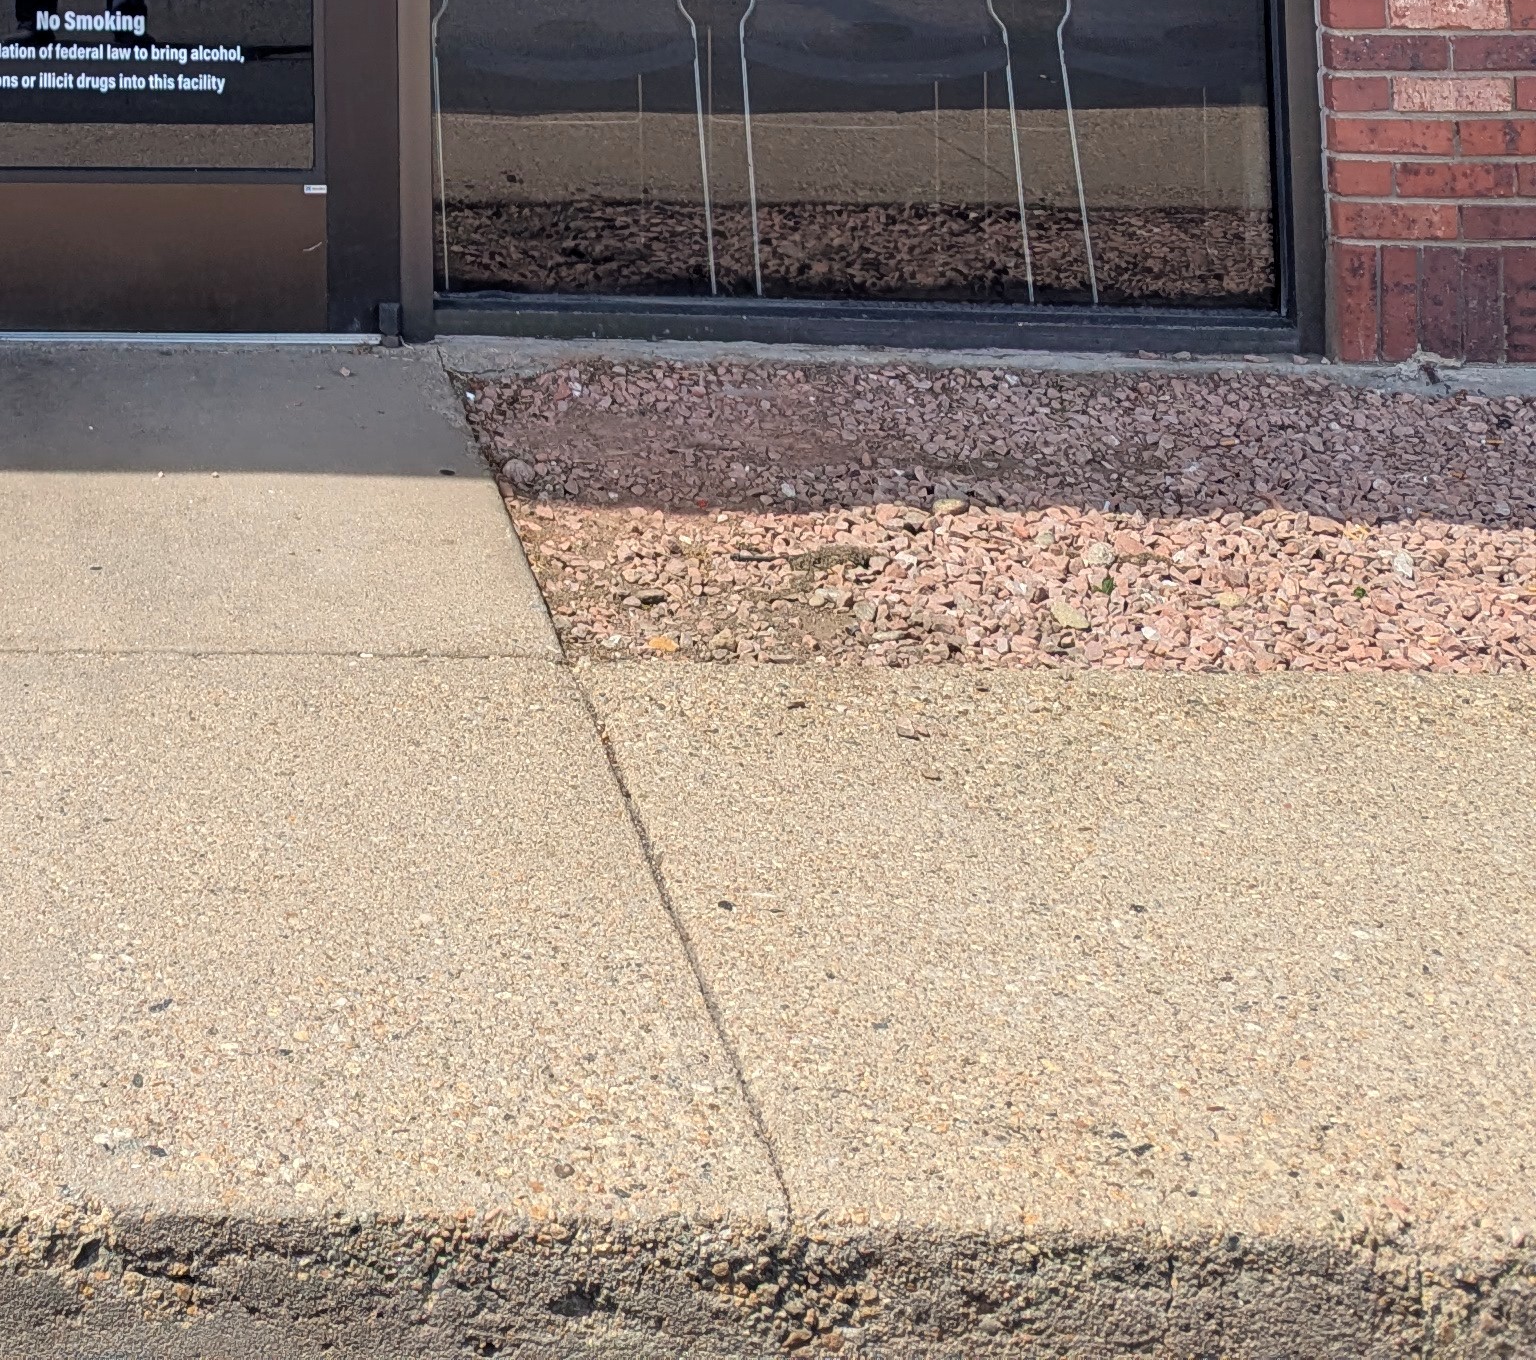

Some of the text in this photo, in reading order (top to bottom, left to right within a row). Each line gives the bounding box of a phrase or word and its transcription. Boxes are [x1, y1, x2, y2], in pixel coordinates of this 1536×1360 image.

[36, 10, 146, 35] No Smoking
[38, 43, 55, 59] of
[55, 43, 104, 60] federal
[106, 43, 132, 60] law
[133, 45, 149, 60] to
[151, 44, 188, 65] bring
[190, 44, 245, 64] alcohol,
[21, 75, 37, 89] or
[39, 72, 74, 89] illicit
[76, 72, 117, 92] drugs
[118, 72, 146, 89] into
[147, 73, 175, 90] this
[176, 73, 227, 95] facility
